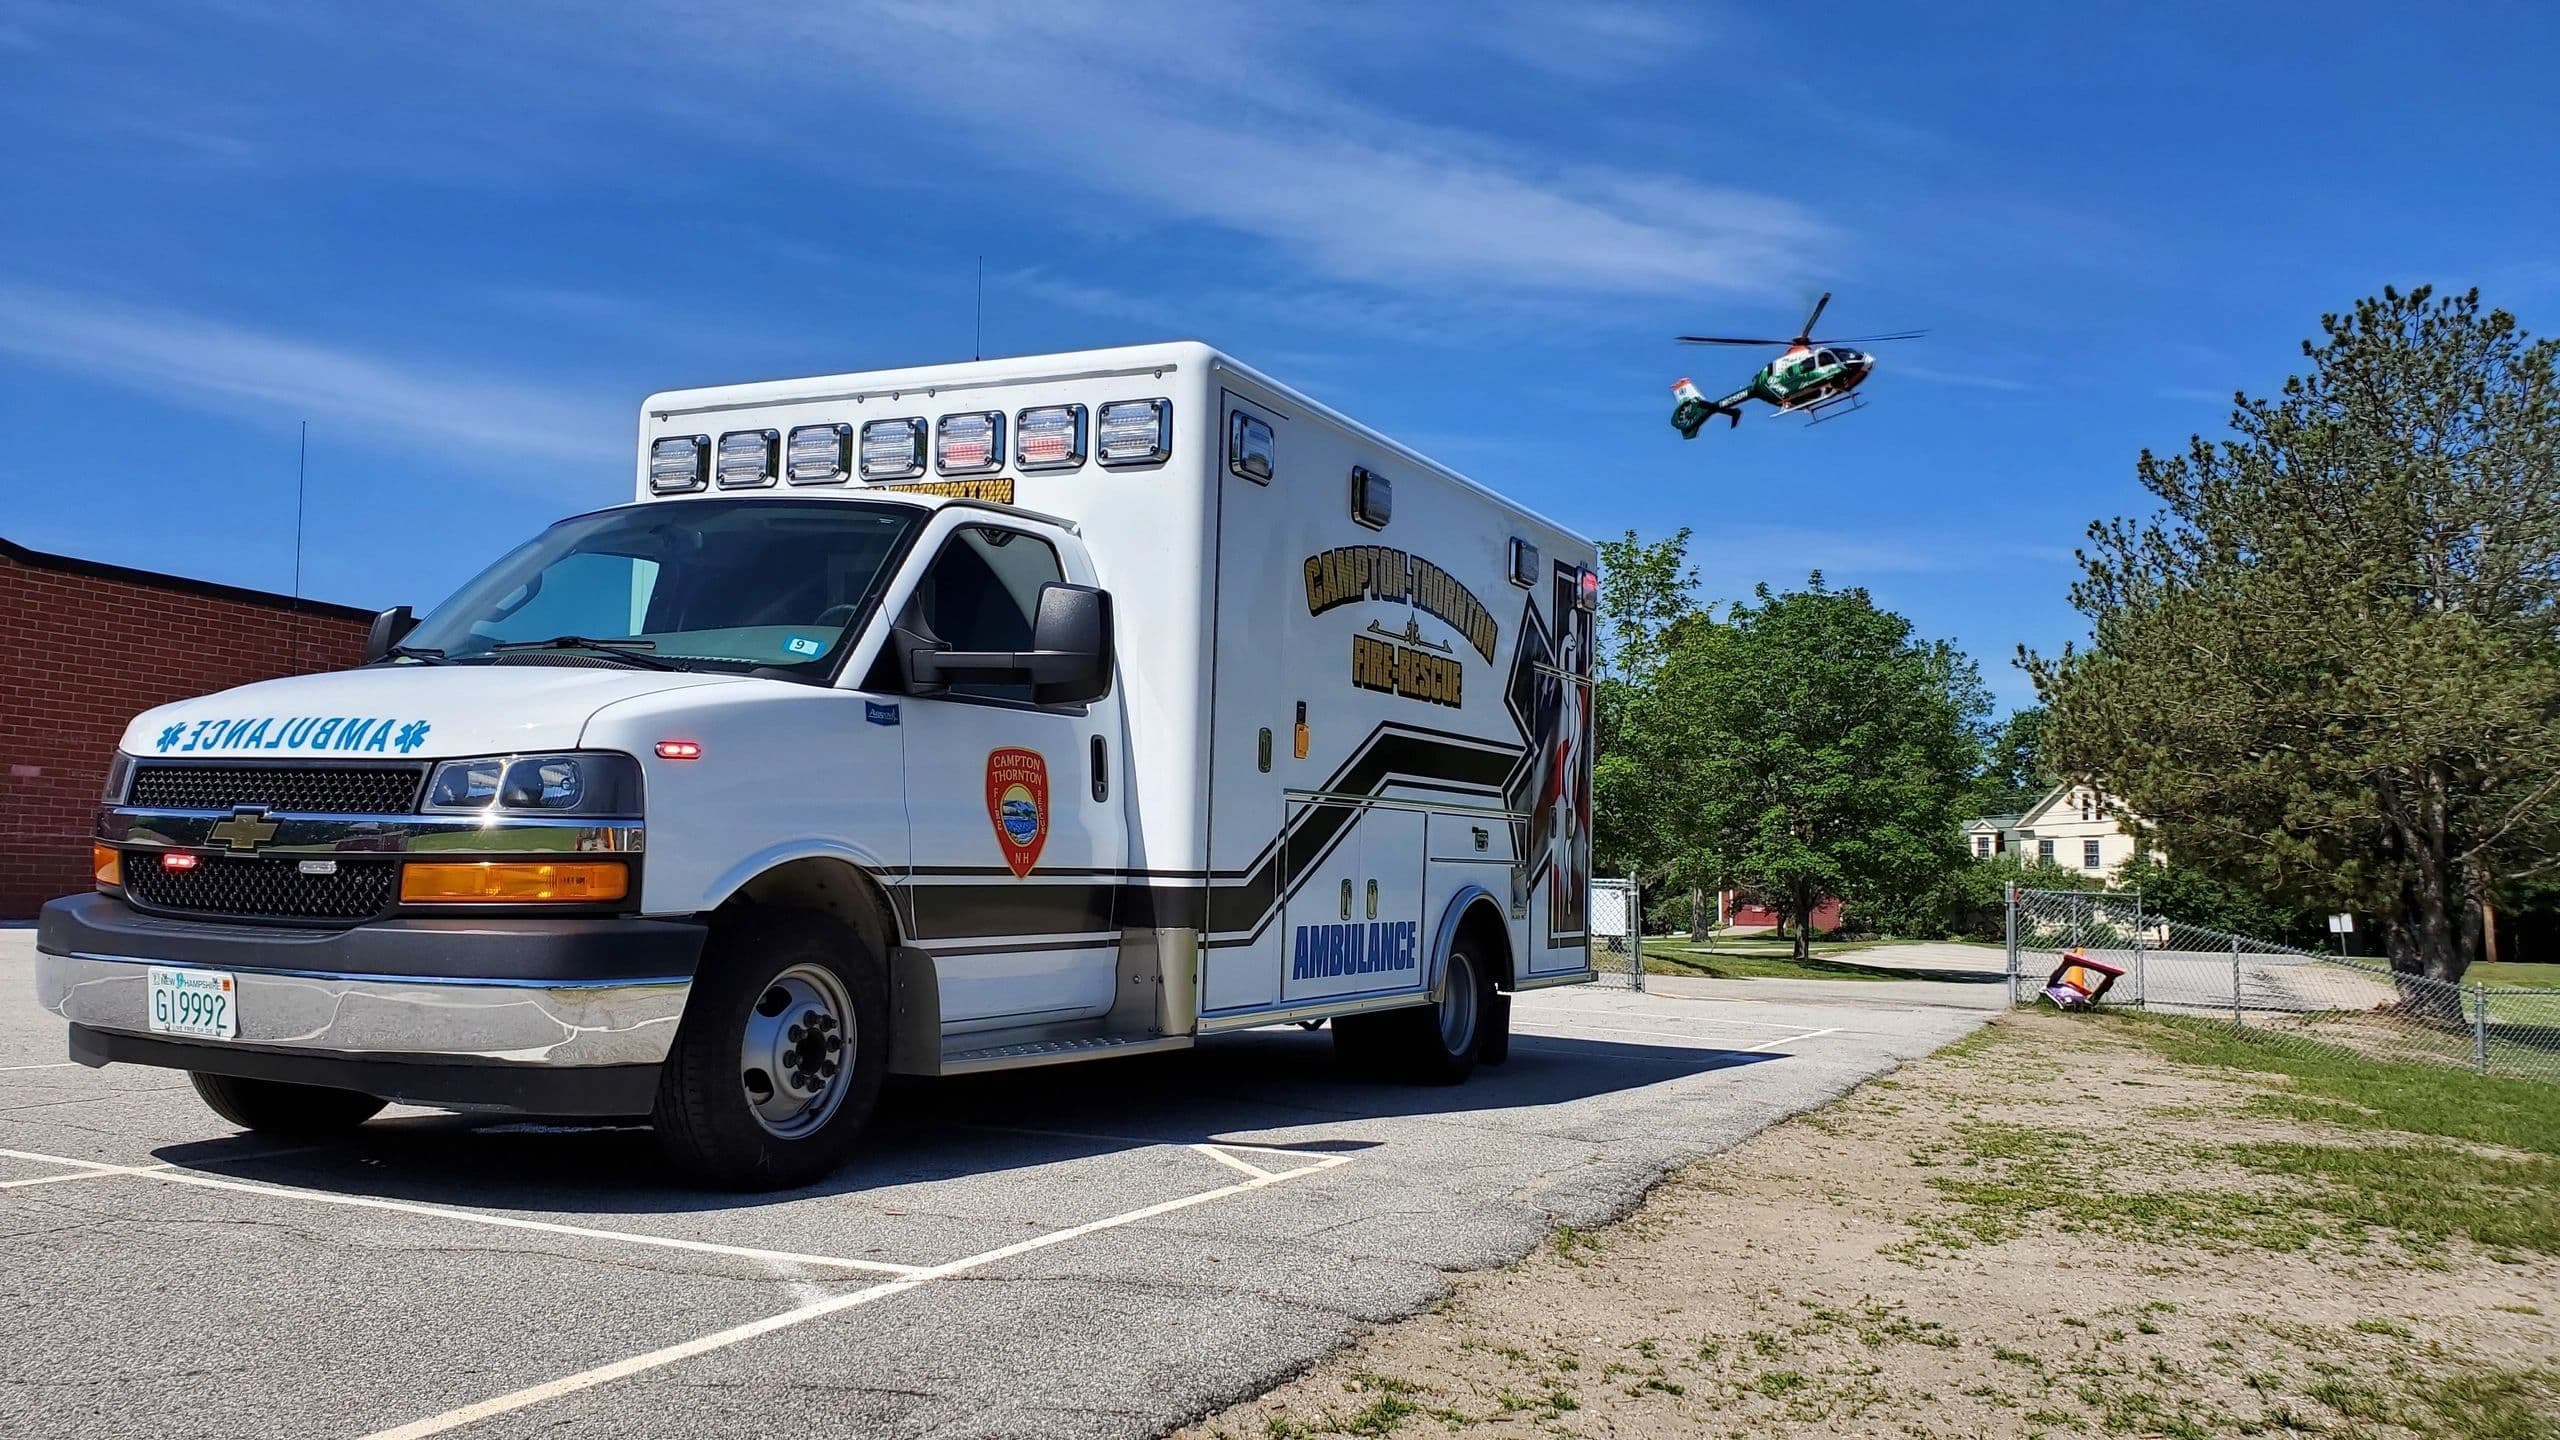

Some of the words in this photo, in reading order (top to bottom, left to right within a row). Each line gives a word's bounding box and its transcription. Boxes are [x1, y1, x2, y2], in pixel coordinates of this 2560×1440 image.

[1304, 545, 1498, 667] CAMPTON-THORNTON
[794, 640, 805, 650] 9
[1352, 633, 1462, 709] FIRE-RESCUE
[993, 755, 1041, 772] CAMPTON
[992, 769, 1042, 786] THORNTON
[1292, 921, 1417, 981] AMBULANCE
[160, 975, 176, 986] NEW
